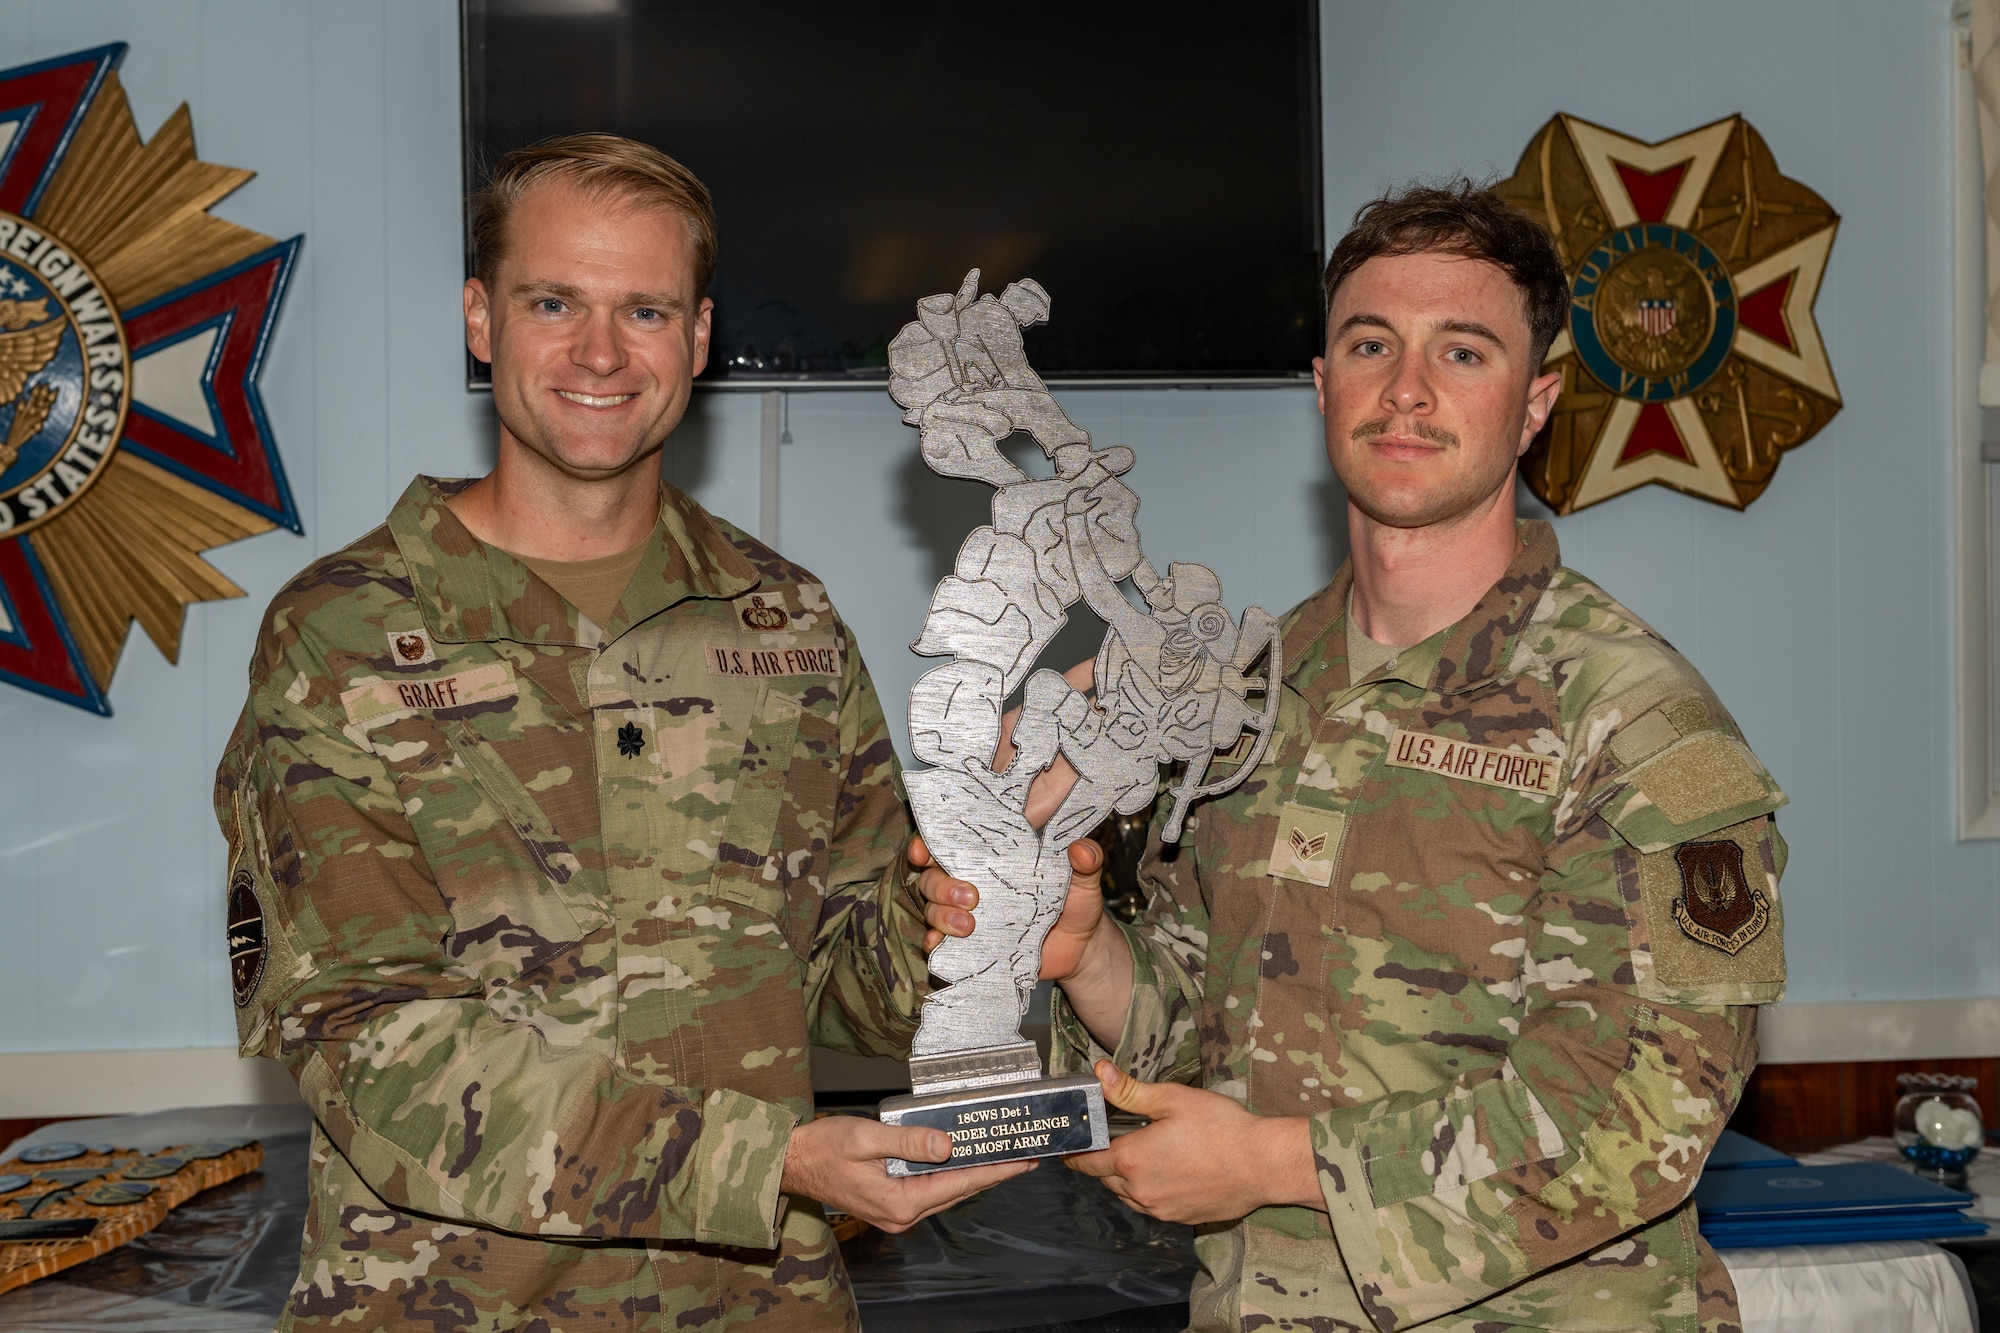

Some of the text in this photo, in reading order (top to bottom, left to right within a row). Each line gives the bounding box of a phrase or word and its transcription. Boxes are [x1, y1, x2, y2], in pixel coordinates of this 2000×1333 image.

[1572, 225, 1736, 313] AUXILIARY
[69, 287, 123, 393] WARS
[19, 405, 118, 519] STATES
[715, 648, 837, 676] U.S. AIR FORCE
[398, 678, 458, 707] GRAFF
[1396, 734, 1553, 791] U.S. AIR FORCE
[1694, 928, 1710, 940] AIR
[1711, 934, 1740, 950] FORCES
[1737, 932, 1748, 942] IN
[946, 1115, 1071, 1143] NDER CHALLENGE
[957, 1105, 1032, 1125] 18CWS Det 1
[950, 1133, 1051, 1158] 026 MOST ARMY
